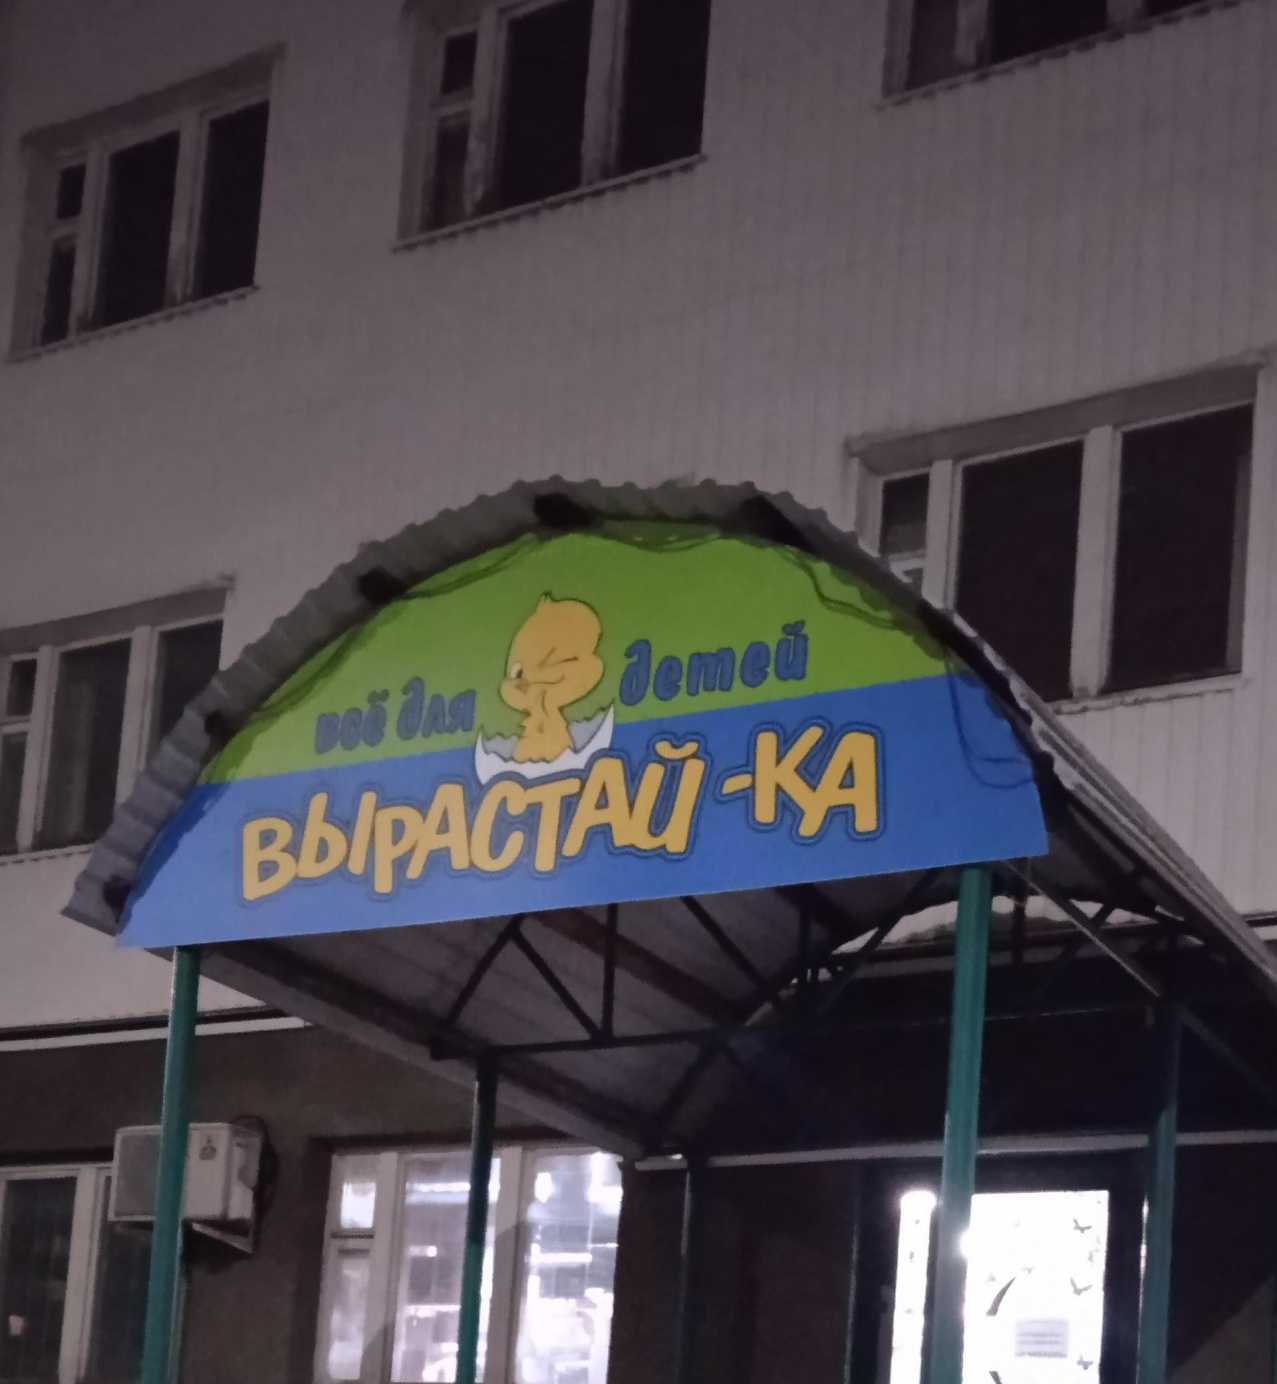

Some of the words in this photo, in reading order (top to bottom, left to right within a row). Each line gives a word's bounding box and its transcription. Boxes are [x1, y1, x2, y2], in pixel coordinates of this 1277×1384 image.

[315, 689, 390, 754] всё
[396, 676, 476, 740] для
[619, 620, 809, 706] детей
